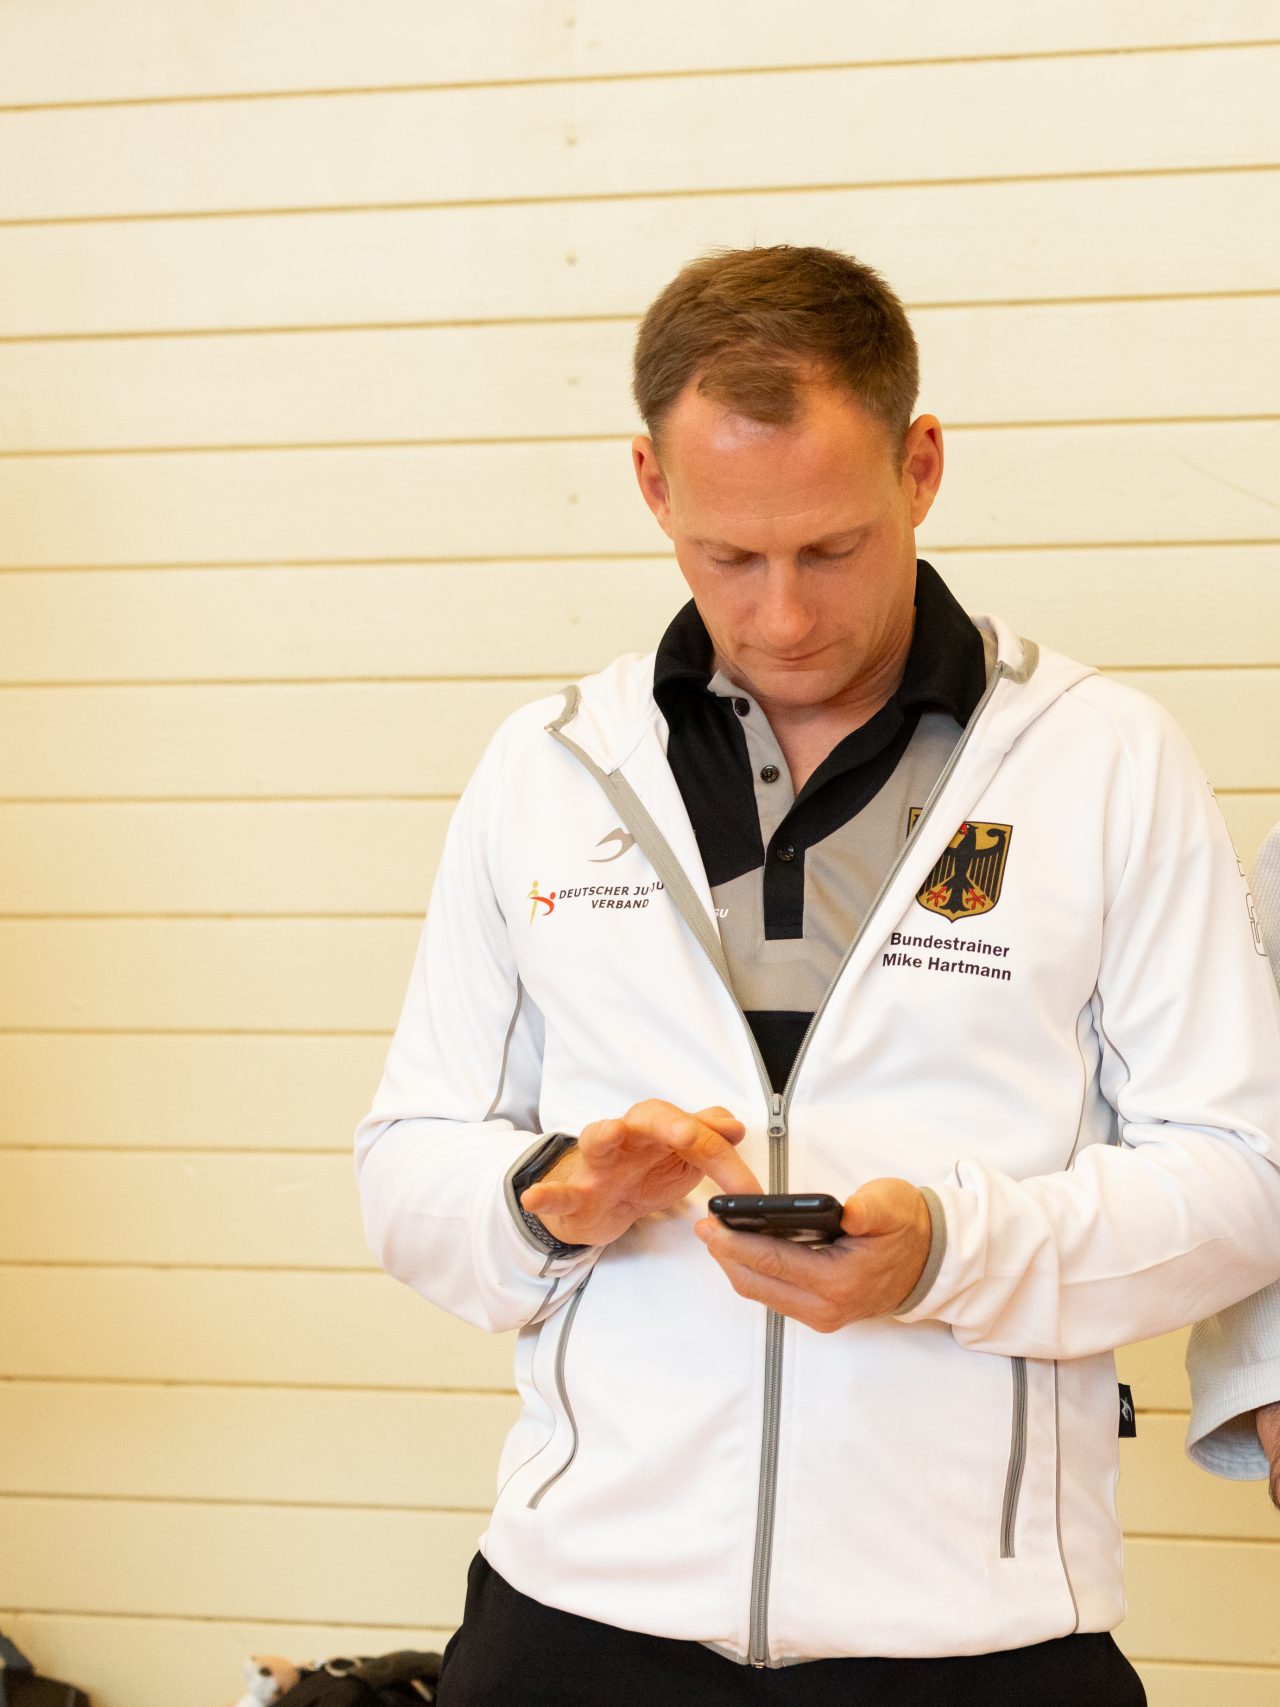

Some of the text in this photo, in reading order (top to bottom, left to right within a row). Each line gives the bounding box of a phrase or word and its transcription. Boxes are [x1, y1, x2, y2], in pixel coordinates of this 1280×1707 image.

[559, 886, 629, 899] DEUTSCHER
[591, 899, 649, 909] VERBAND
[890, 932, 1010, 957] Bundestrainer
[882, 953, 1012, 981] Mike Hartmann
